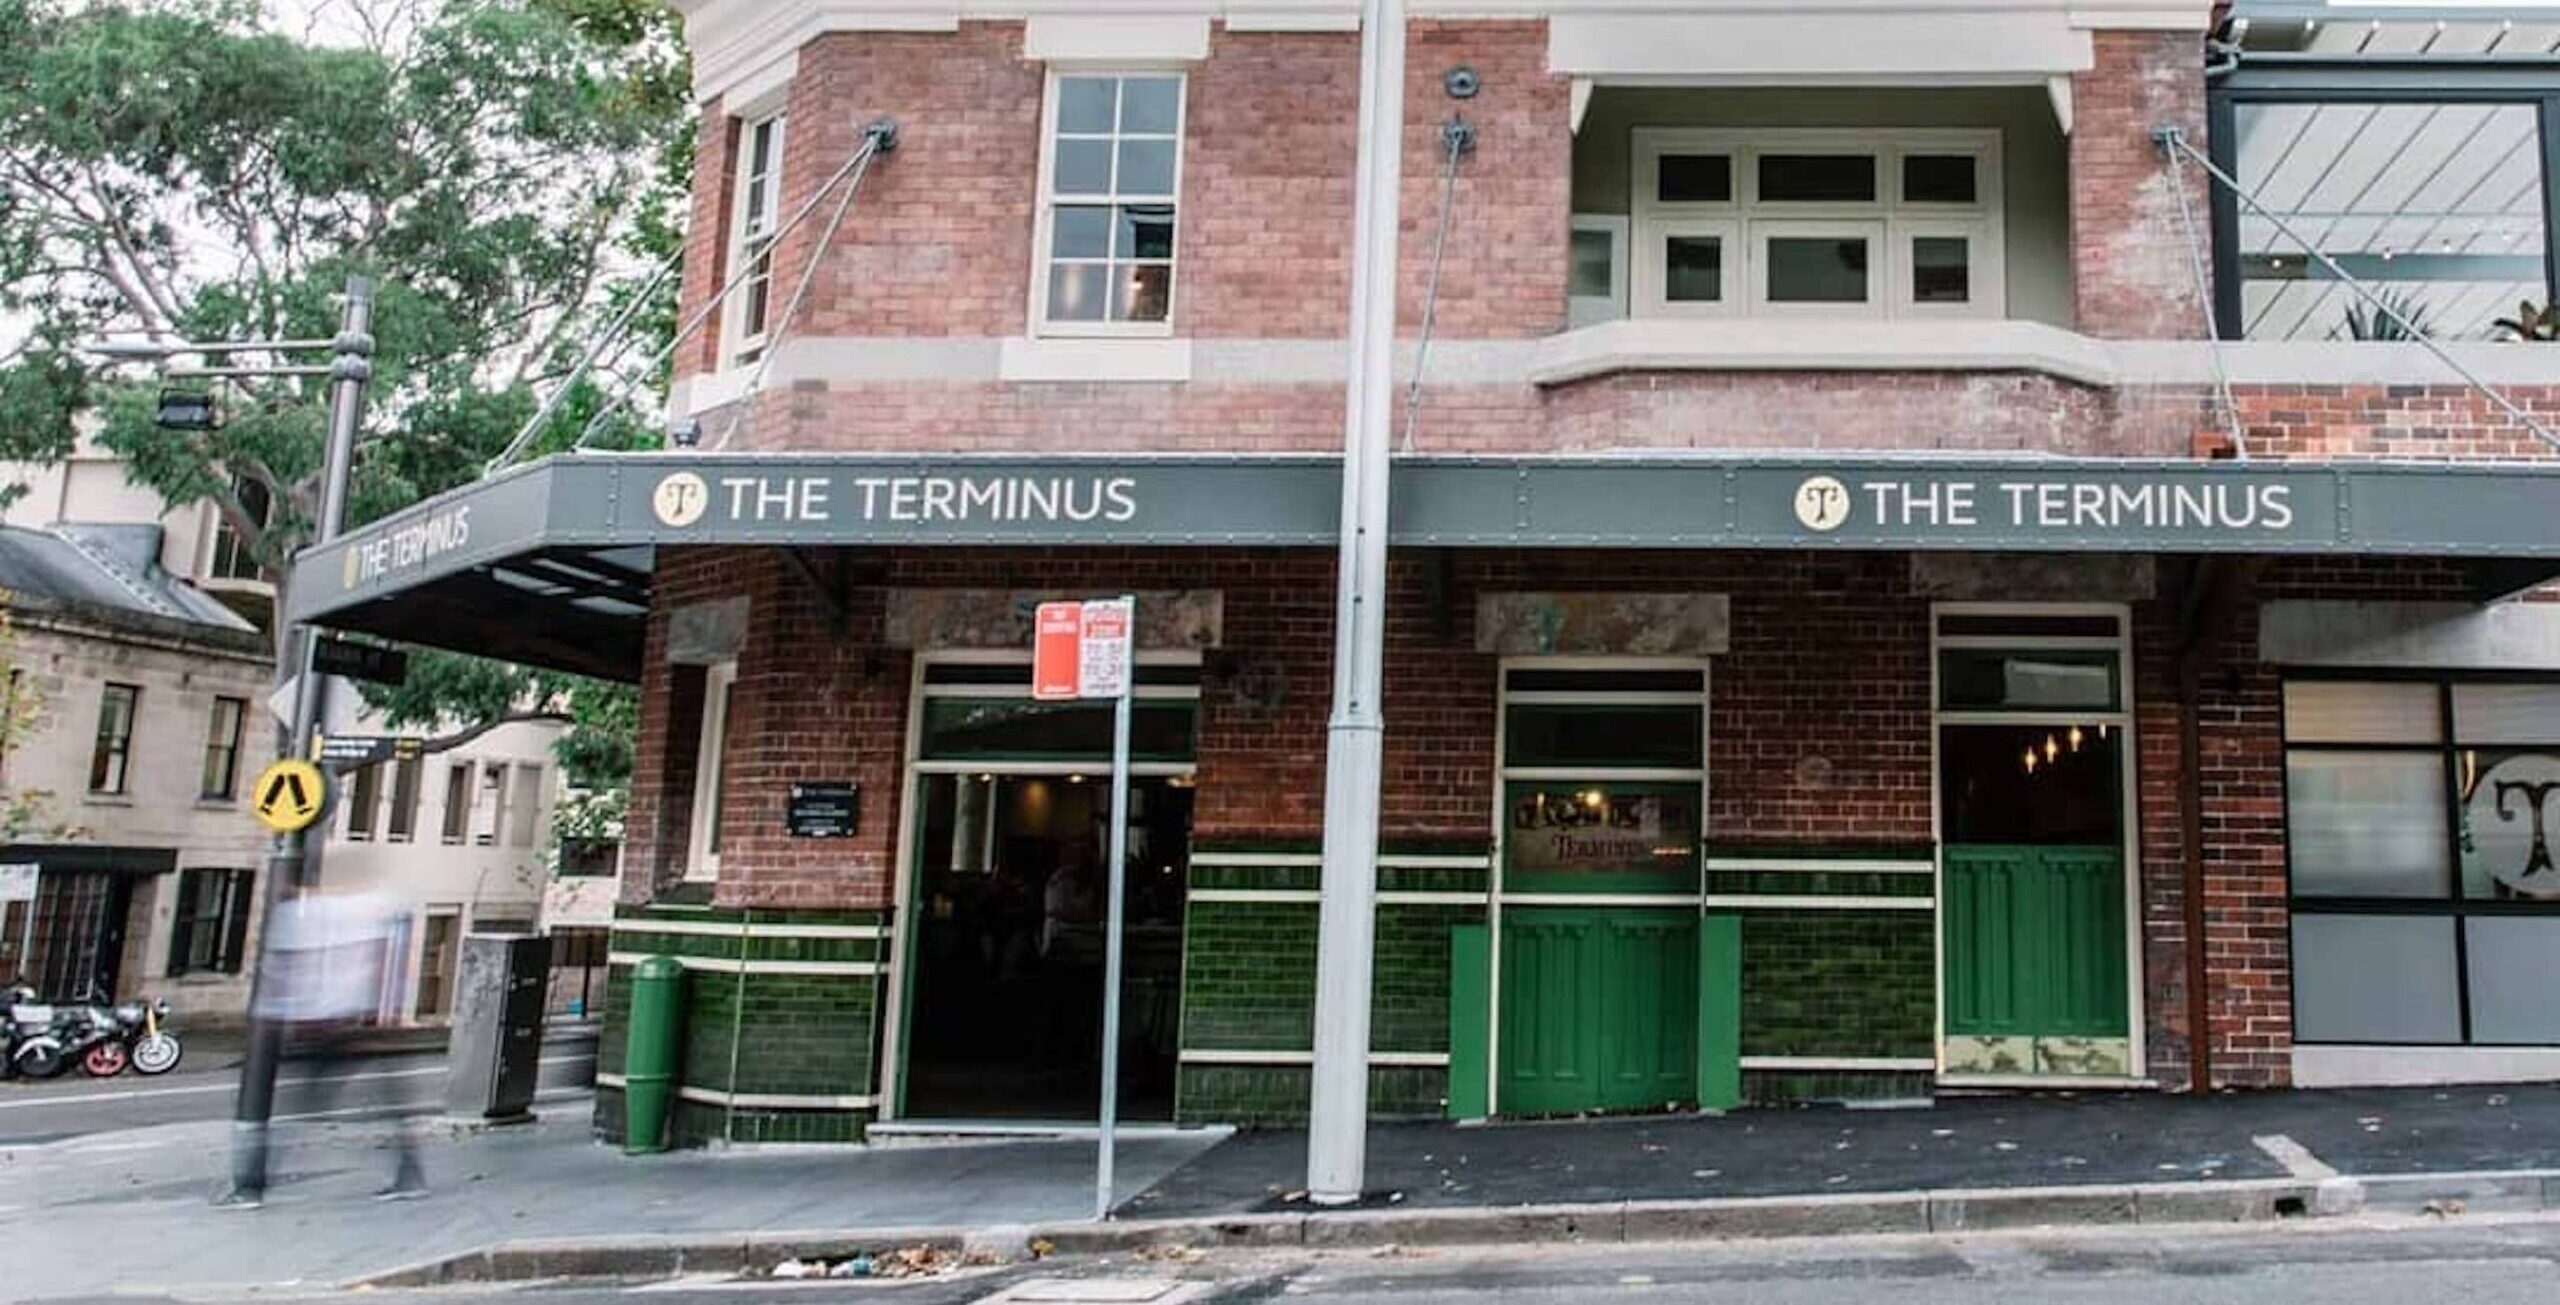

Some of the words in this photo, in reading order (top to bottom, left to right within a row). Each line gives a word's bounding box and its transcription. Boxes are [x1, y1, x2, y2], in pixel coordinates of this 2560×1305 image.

[720, 477, 831, 521] THE
[853, 477, 1137, 521] TERMINUS
[1862, 482, 1977, 525] THE
[1999, 483, 2293, 528] TERMINUS
[359, 538, 391, 583] THE
[392, 504, 471, 569] TERMINUS
